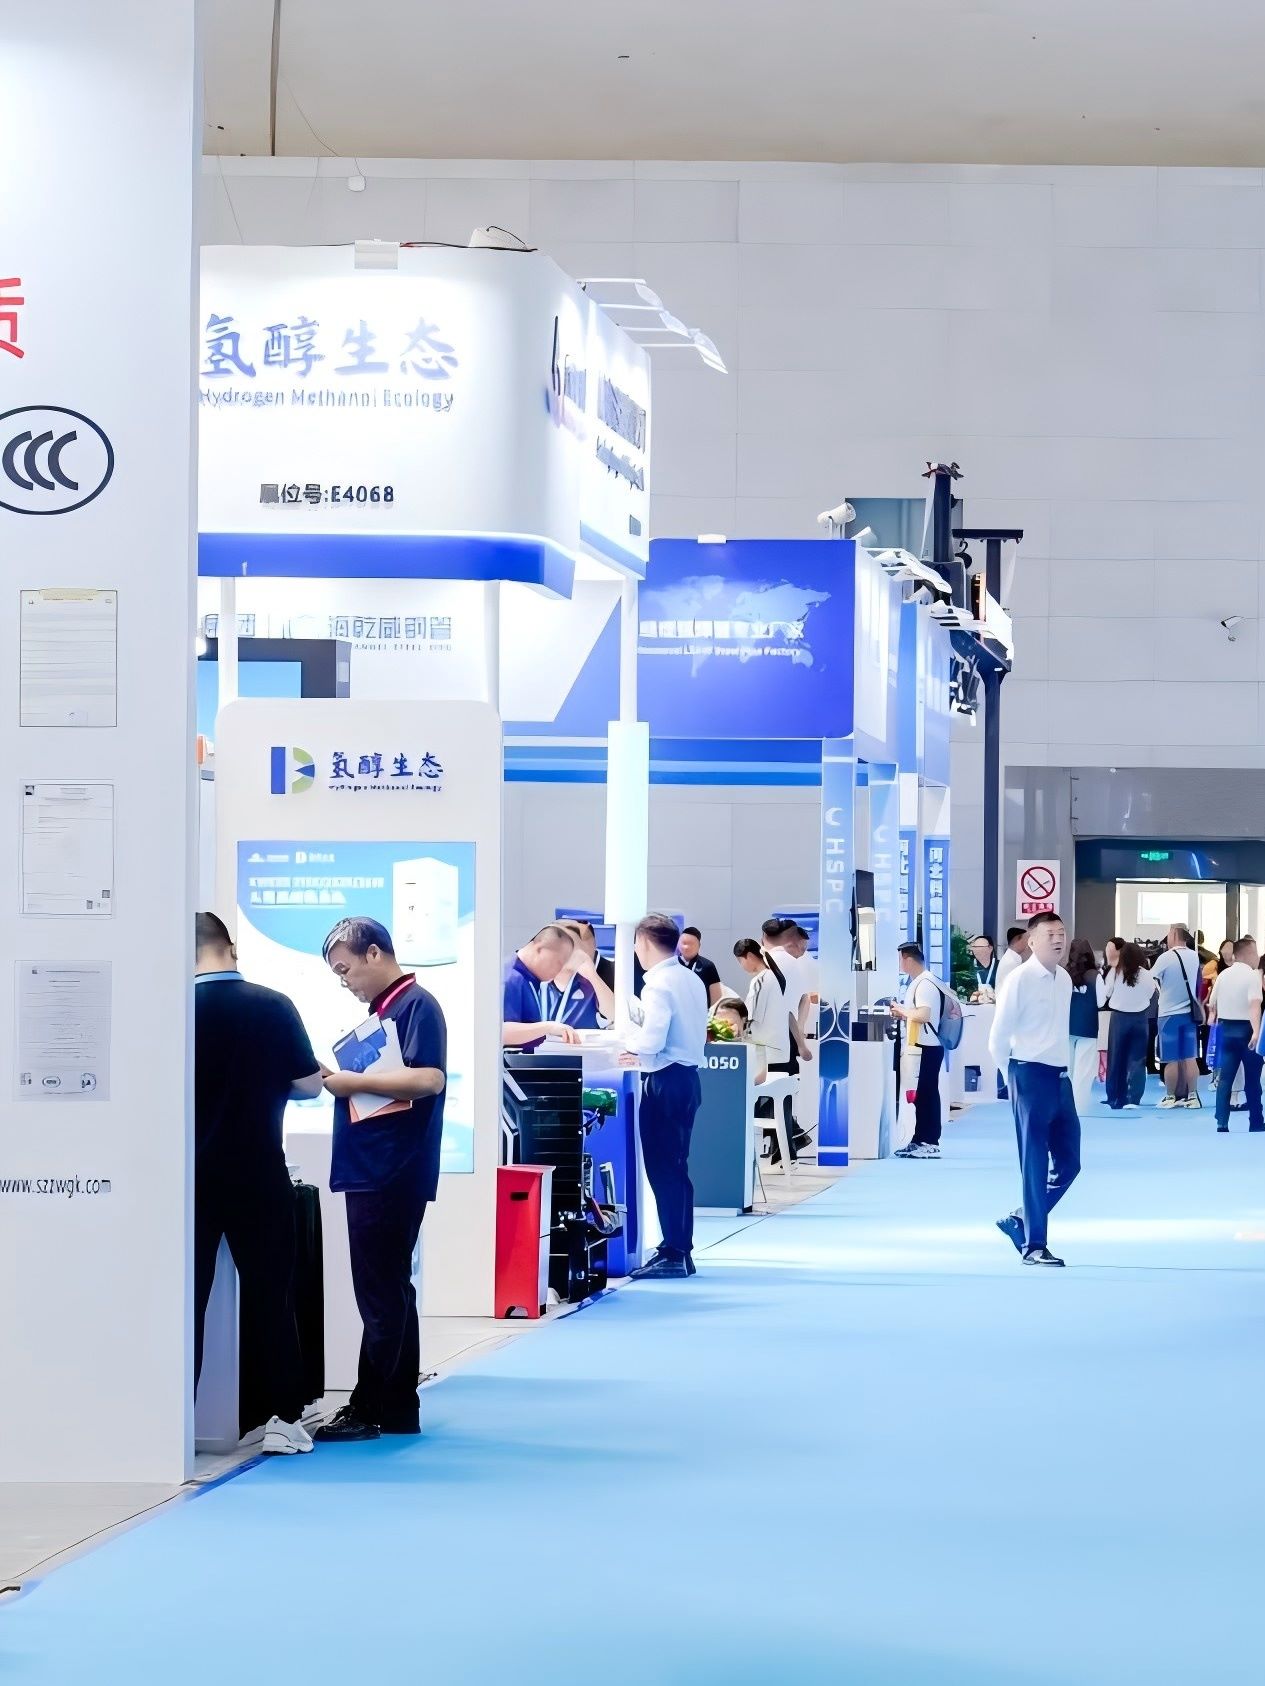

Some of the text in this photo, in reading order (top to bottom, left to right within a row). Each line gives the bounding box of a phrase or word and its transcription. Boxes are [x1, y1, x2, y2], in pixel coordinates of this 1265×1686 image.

[200, 313, 459, 380] 氢醇生态
[329, 751, 444, 779] 氢醇生态
[706, 1056, 739, 1070] 050
